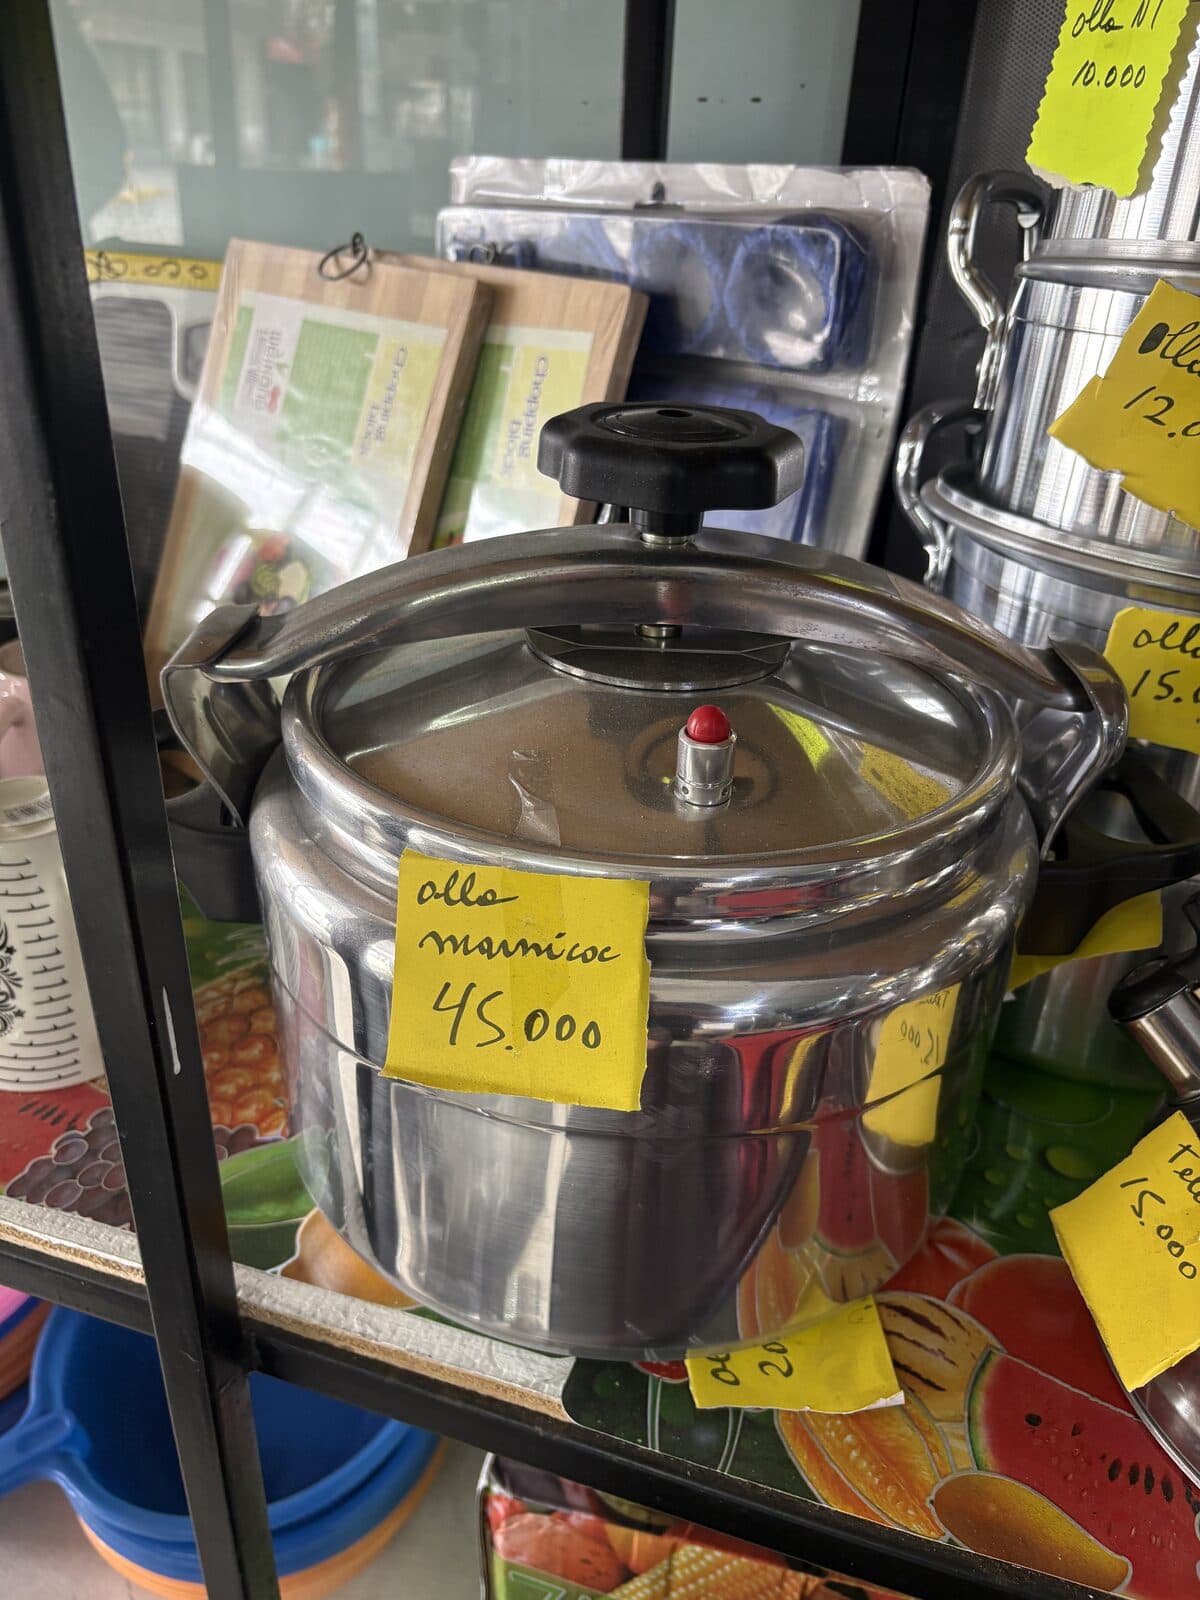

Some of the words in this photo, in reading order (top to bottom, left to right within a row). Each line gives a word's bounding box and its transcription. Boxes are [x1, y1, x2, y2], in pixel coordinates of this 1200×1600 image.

[1072, 60, 1146, 89] 10.000
[518, 355, 549, 459] Chopping
[432, 981, 602, 1051] 45.000
[1120, 1177, 1198, 1280] 15.000
